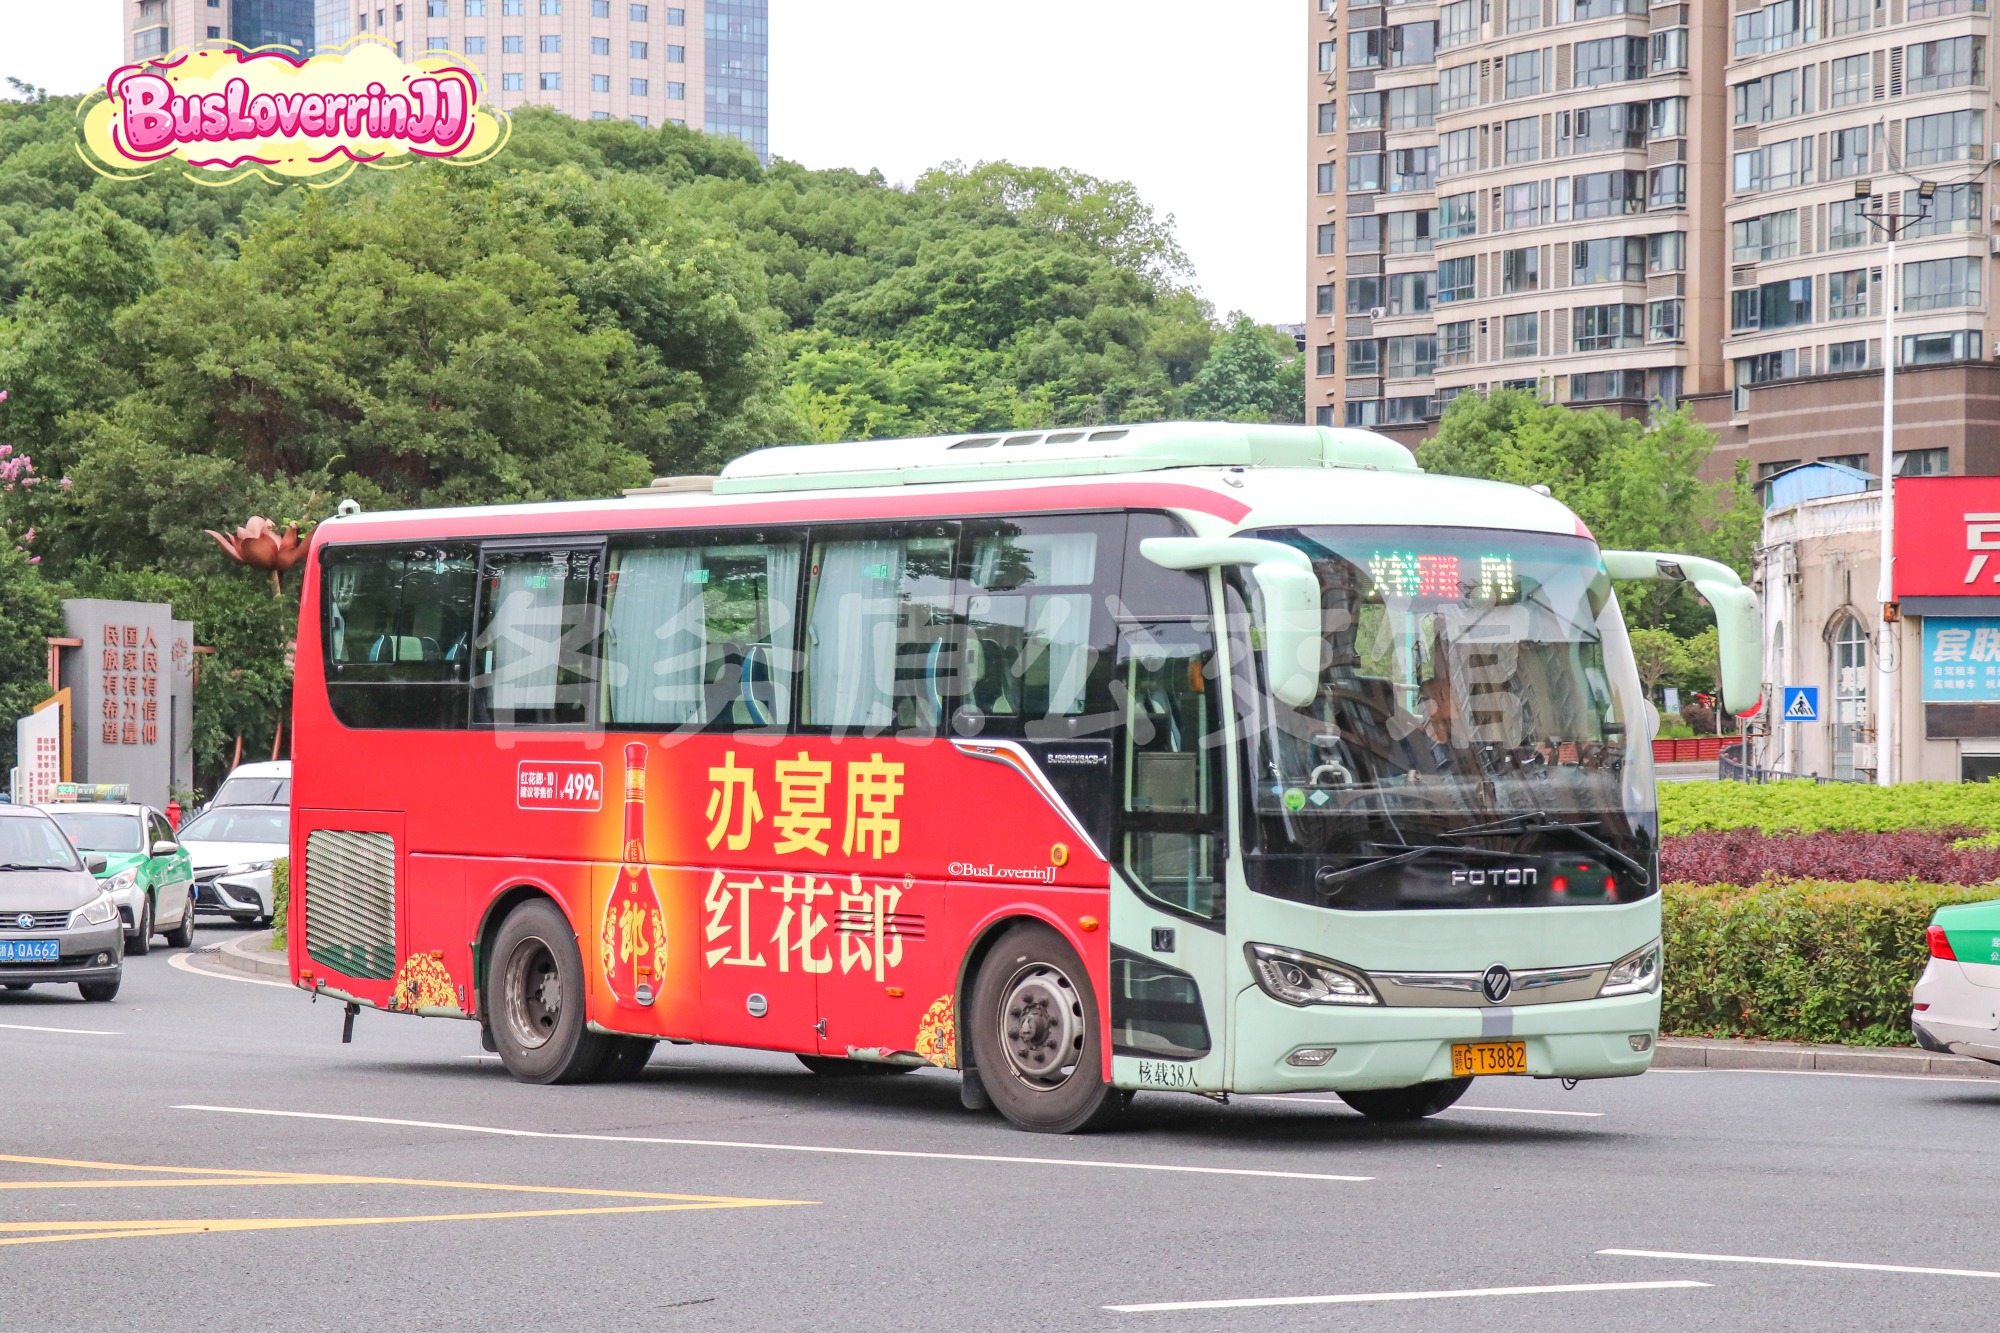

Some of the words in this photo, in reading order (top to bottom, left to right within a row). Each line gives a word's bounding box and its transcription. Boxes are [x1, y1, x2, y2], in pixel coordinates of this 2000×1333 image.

[103, 624, 119, 744] 民族有希望
[123, 625, 138, 744] 国家有力量
[142, 626, 158, 745] 人民有信仰
[1934, 666, 1976, 676] 自驾租车
[1986, 666, 2000, 676] 商
[520, 786, 554, 799] 建议零售价
[706, 751, 905, 859] 办宴席
[705, 869, 903, 982] 红花郎
[1139, 1061, 1198, 1087] 核载38人
